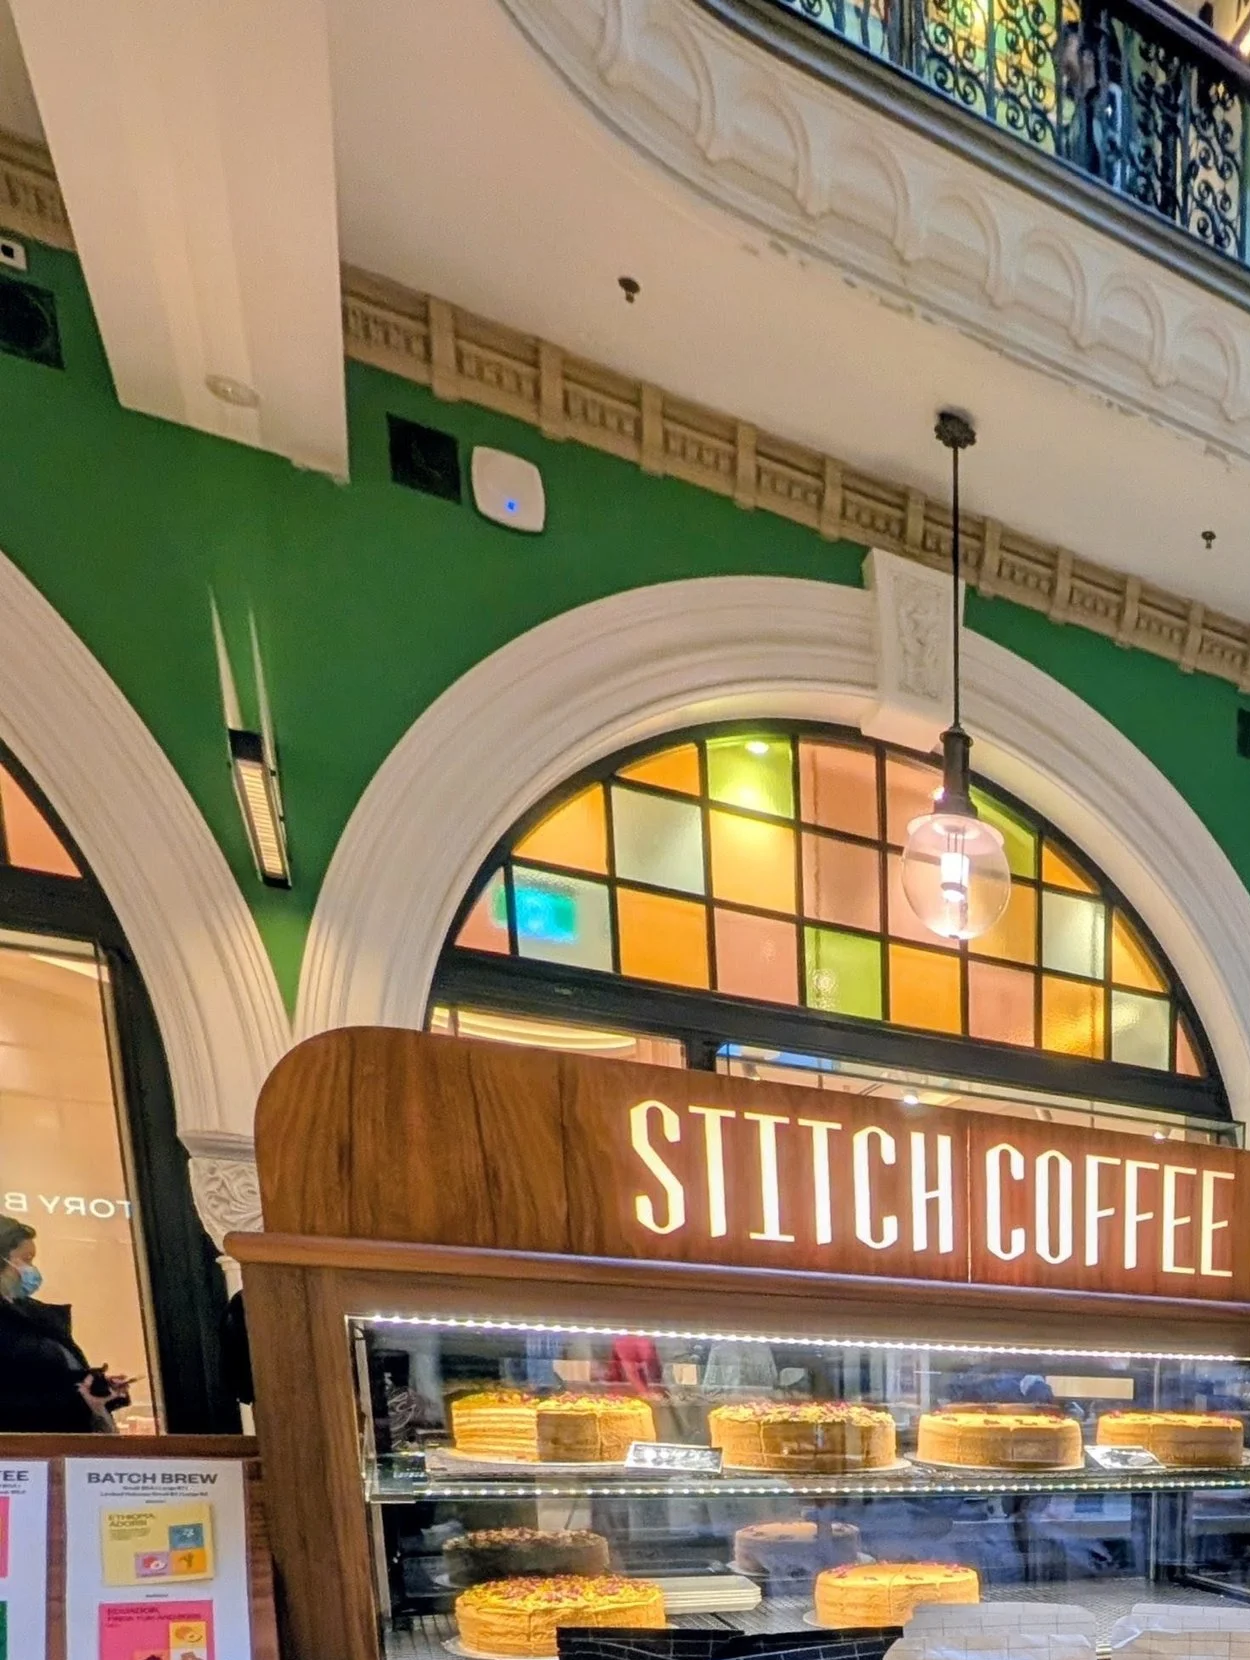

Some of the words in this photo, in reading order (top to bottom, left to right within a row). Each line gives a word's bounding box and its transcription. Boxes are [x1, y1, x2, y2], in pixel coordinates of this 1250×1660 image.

[630, 1099, 953, 1254] STITCH
[985, 1142, 1236, 1278] COFFEE
[87, 1472, 157, 1484] BATCH
[161, 1473, 218, 1485] BREW
